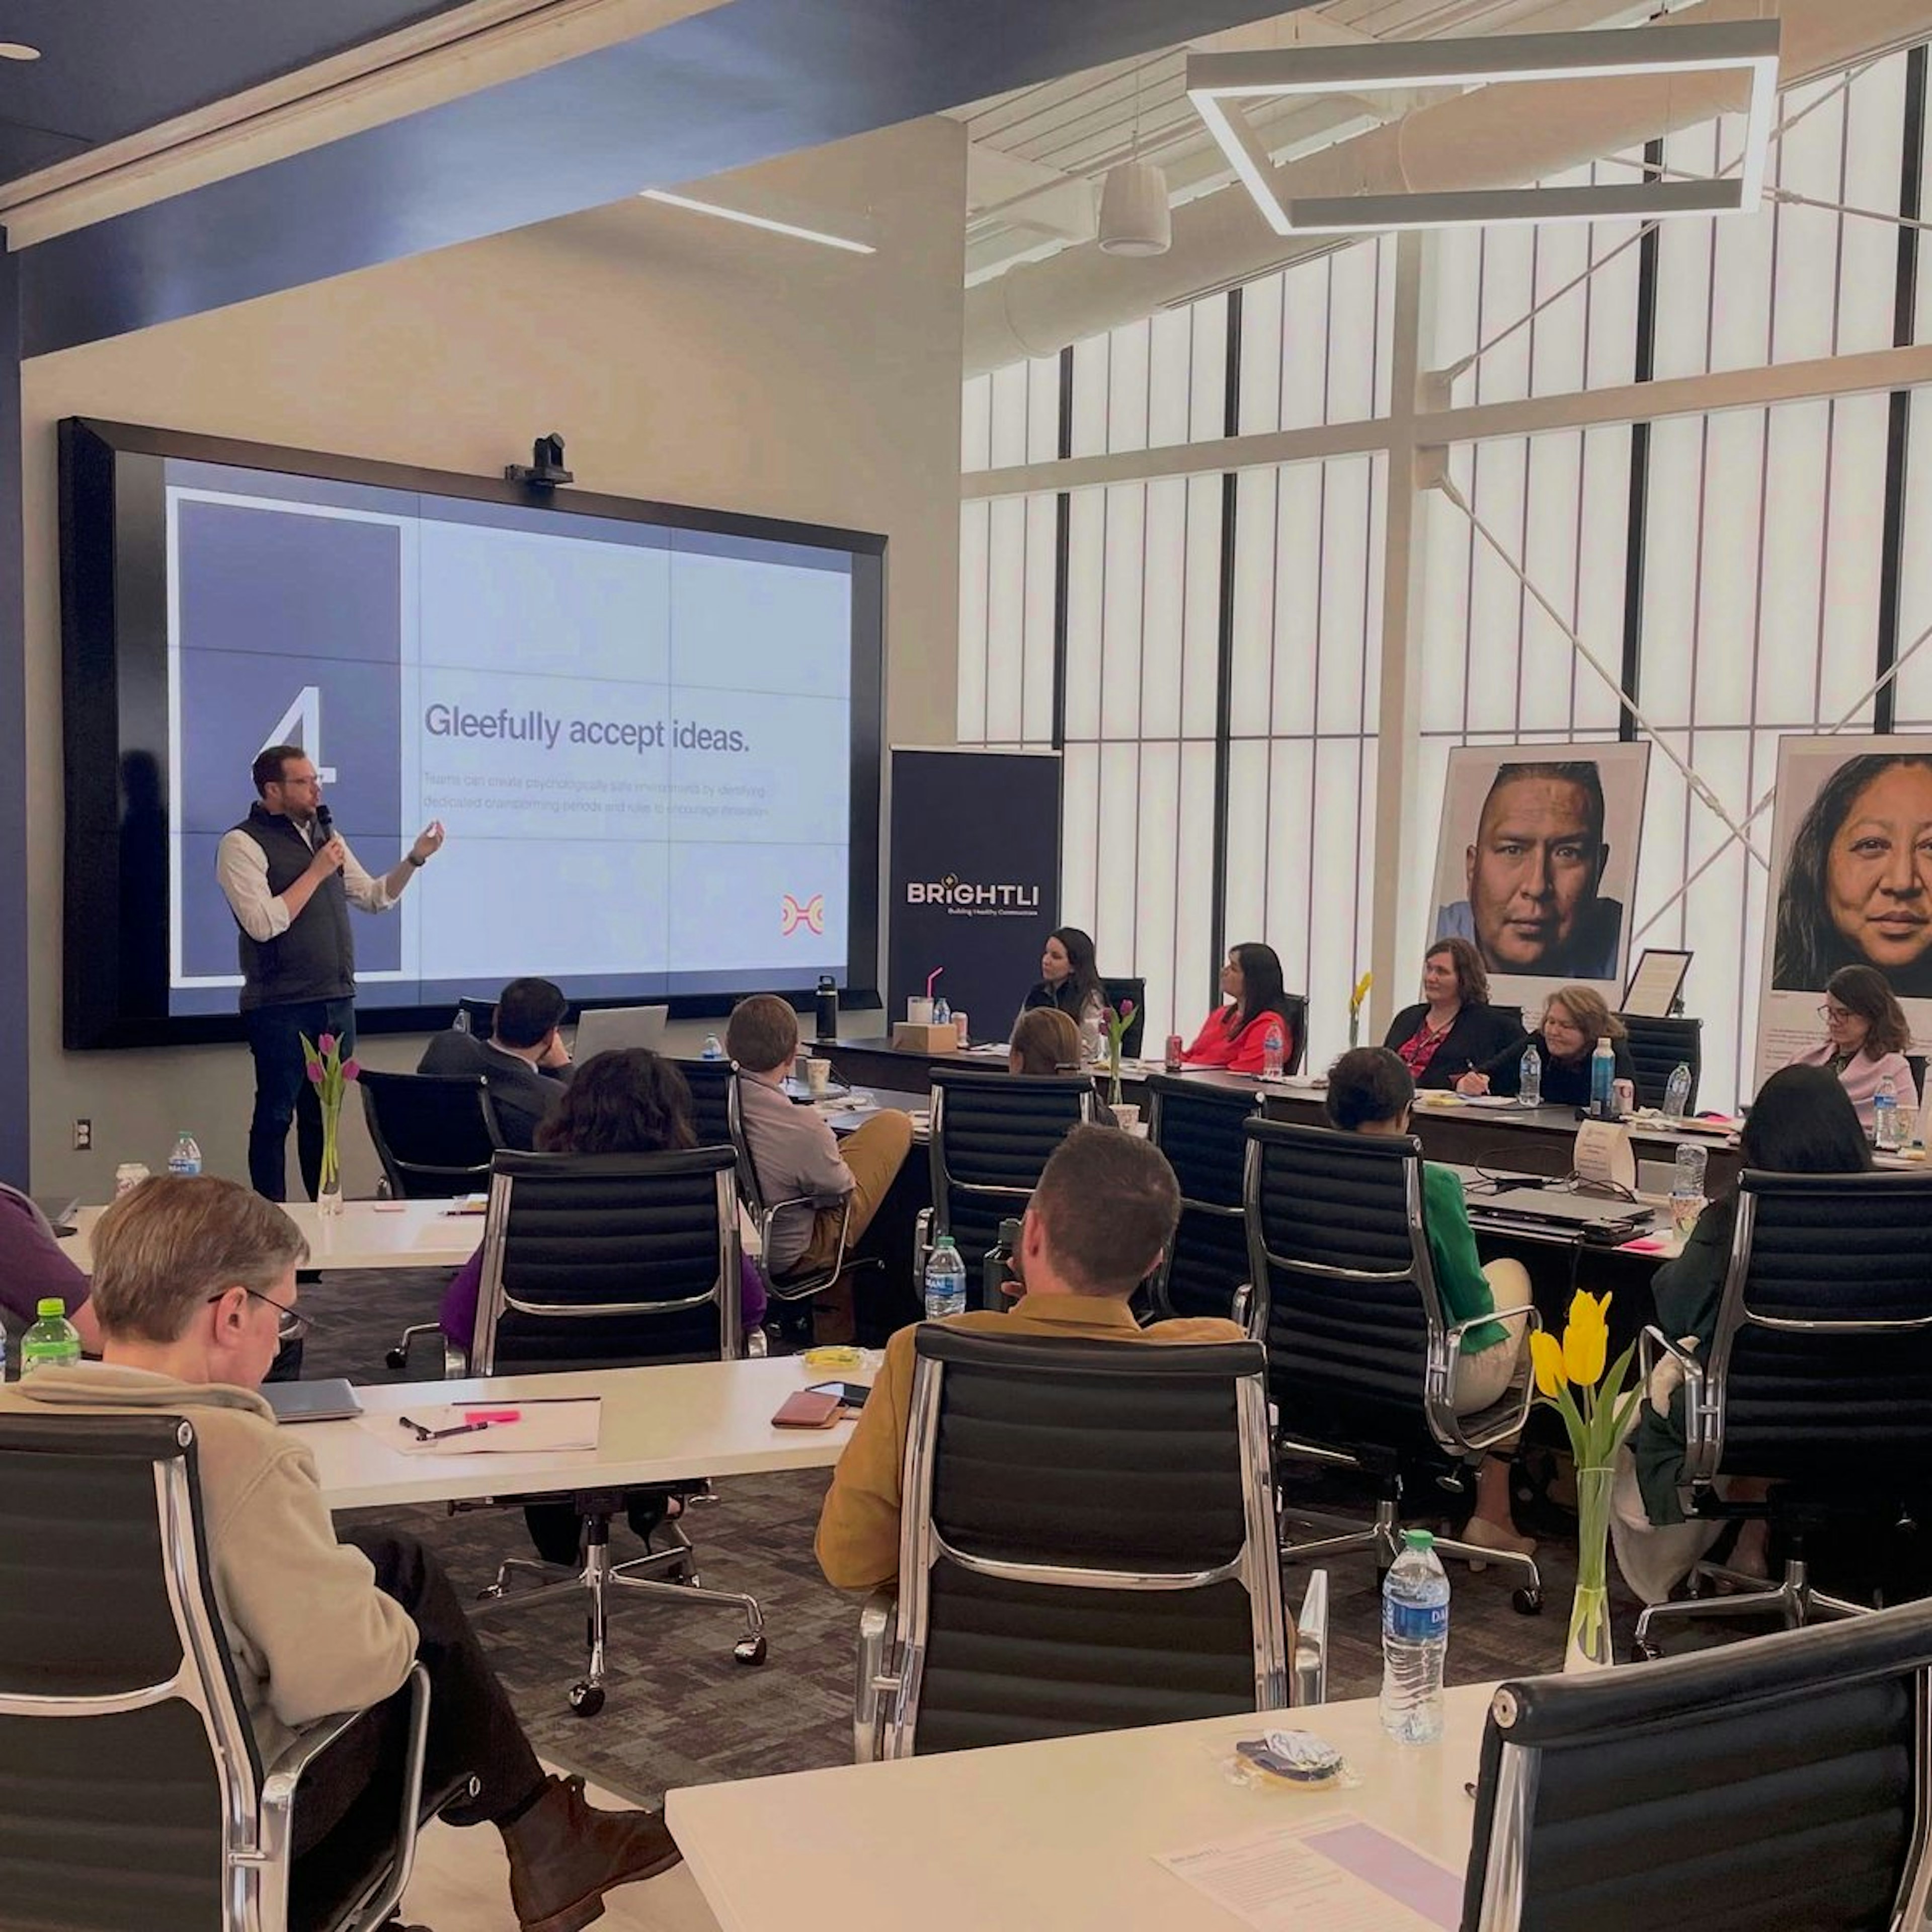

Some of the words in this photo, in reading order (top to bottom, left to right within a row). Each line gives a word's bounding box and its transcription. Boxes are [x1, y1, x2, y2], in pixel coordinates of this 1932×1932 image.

[251, 686, 336, 783] 4
[425, 703, 561, 750] Gleefully
[570, 720, 665, 754] accept
[673, 720, 750, 752] ideas.
[463, 776, 485, 786] can
